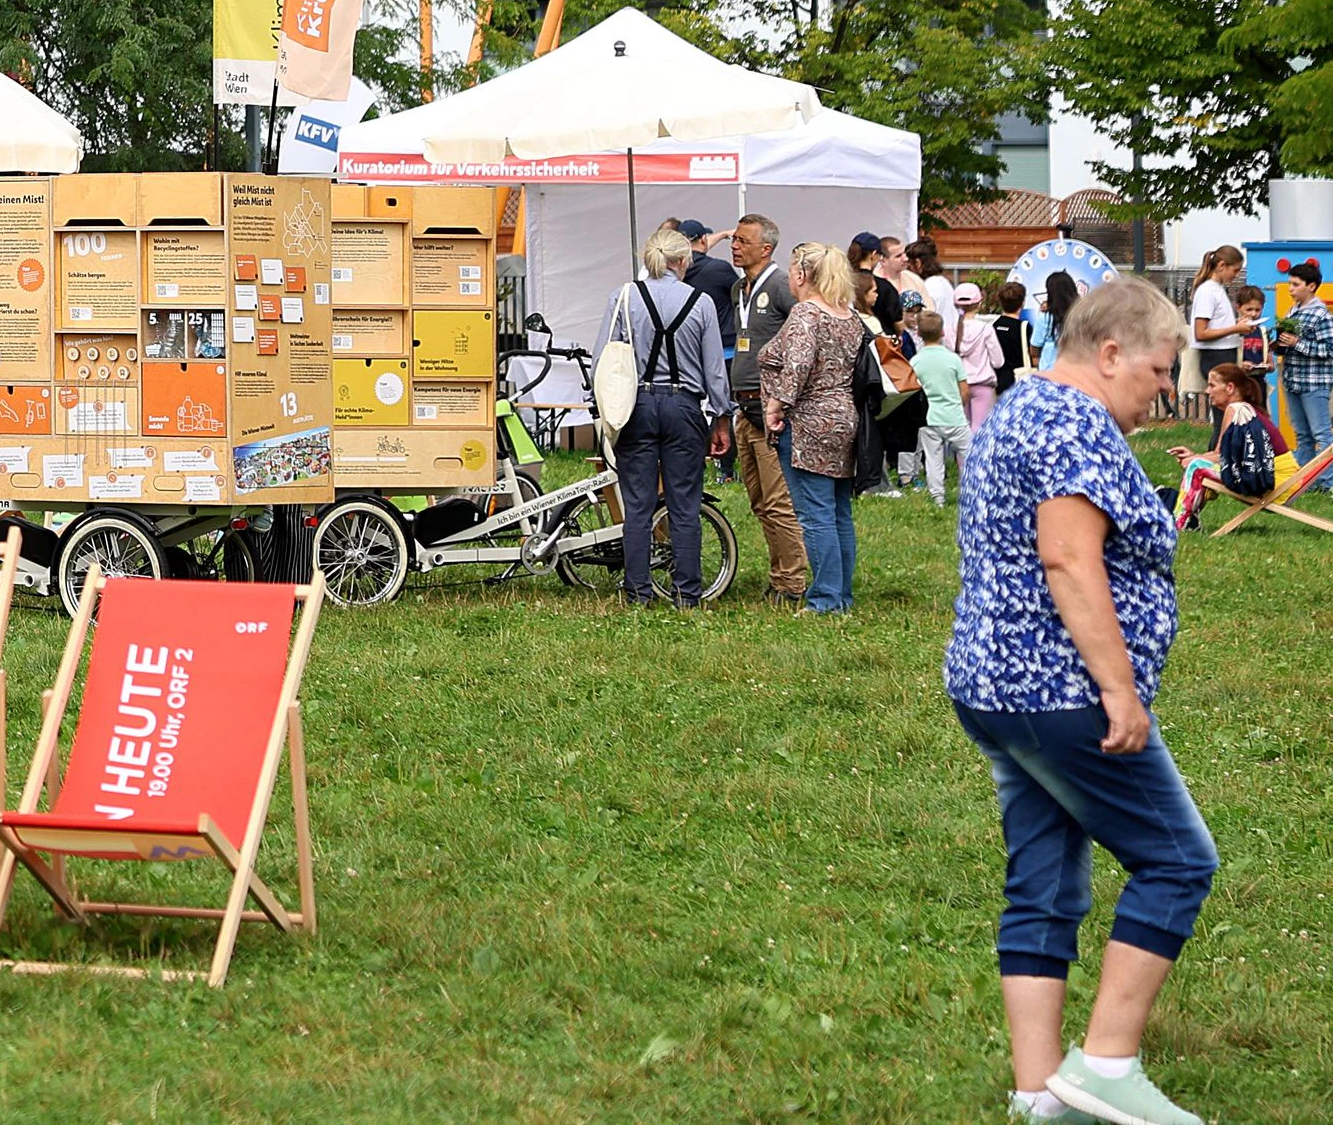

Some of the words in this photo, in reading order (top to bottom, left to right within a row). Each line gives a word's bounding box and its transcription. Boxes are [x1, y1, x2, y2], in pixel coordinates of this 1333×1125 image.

[299, 122, 332, 143] KFV
[343, 159, 427, 174] Kuratorium
[458, 161, 600, 176] Verkehrssicherheit
[22, 195, 44, 204] Mist!
[233, 185, 246, 194] Weil
[247, 185, 259, 194] Mist
[260, 186, 274, 195] nicht
[233, 197, 250, 207] gleich
[251, 197, 263, 206] Mist
[64, 232, 106, 258] 100
[189, 313, 203, 324] 25
[280, 392, 297, 416] 13
[497, 515, 508, 525] Ich
[509, 512, 520, 522] bin
[521, 507, 531, 517] ein
[532, 498, 557, 512] Wiener
[235, 621, 269, 633] ORF
[174, 648, 194, 662] 2
[167, 665, 189, 709] ORF
[100, 644, 169, 795] HEUTE
[159, 713, 185, 749] Uhr,
[147, 752, 174, 797] 19.00
